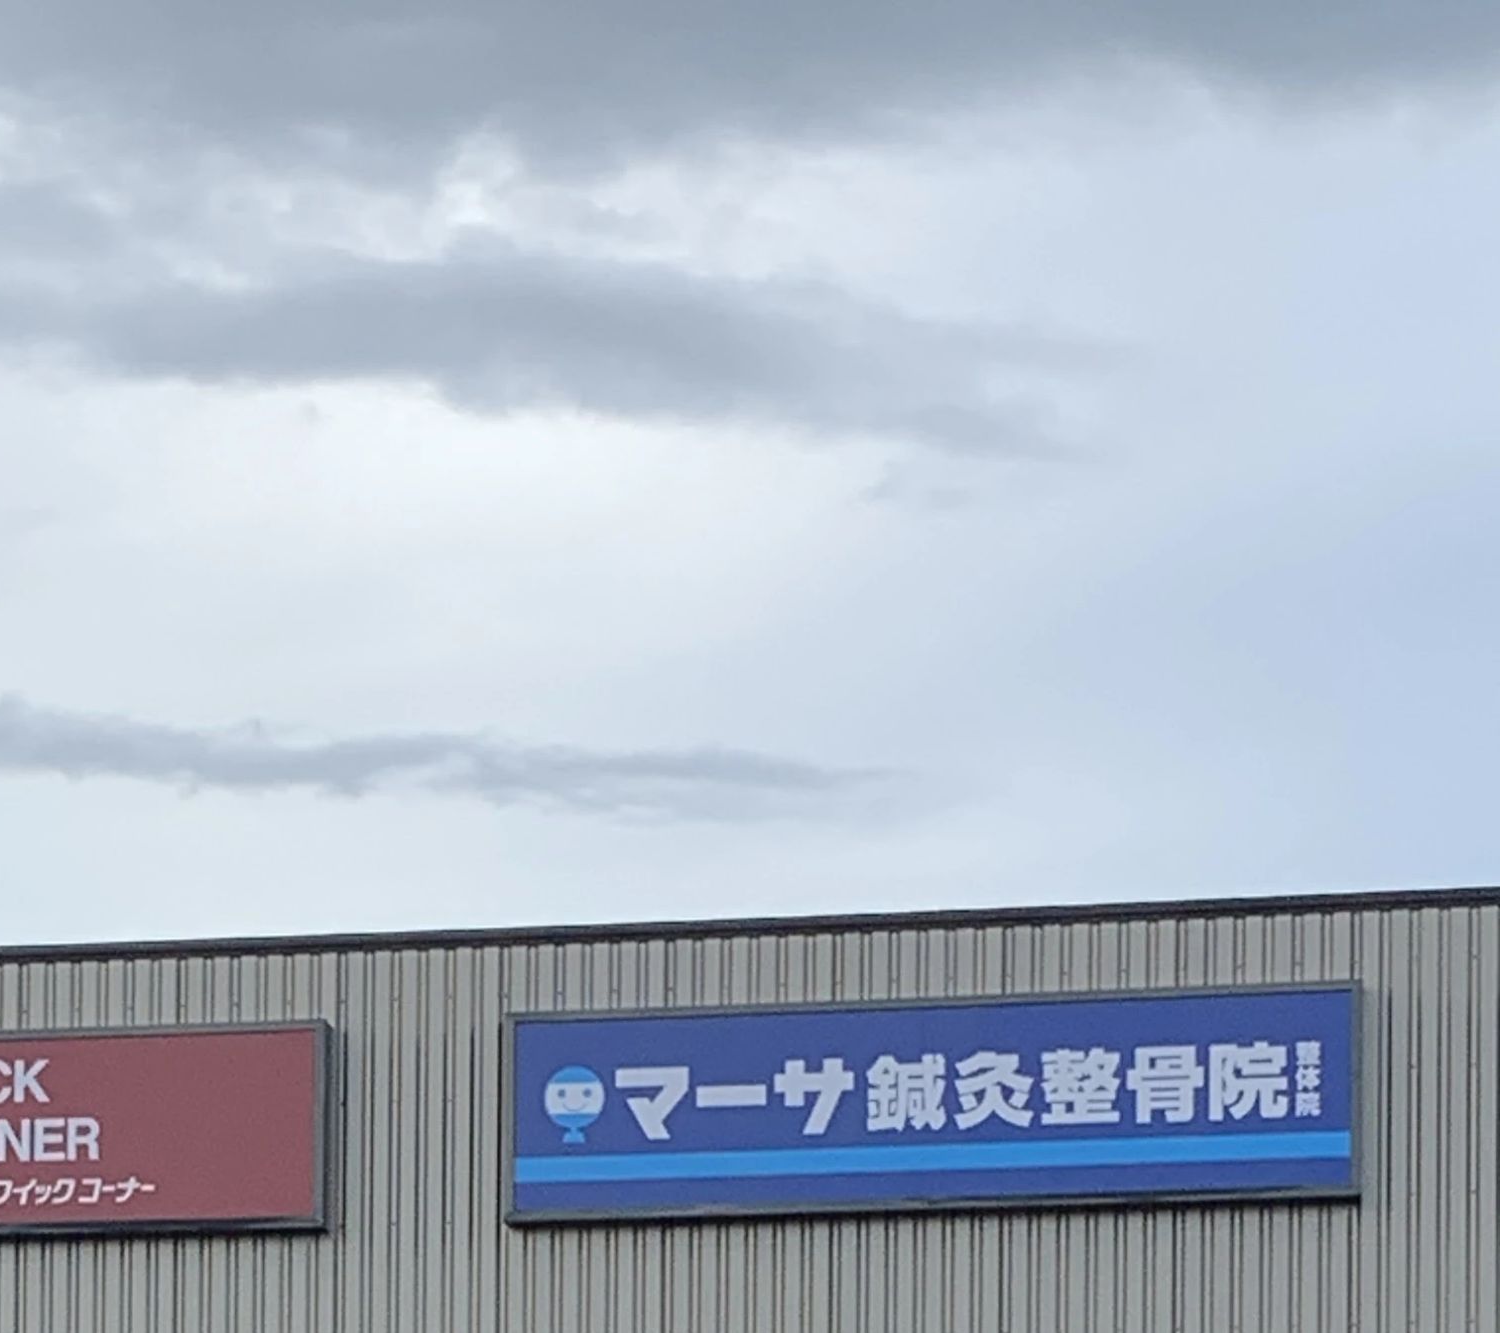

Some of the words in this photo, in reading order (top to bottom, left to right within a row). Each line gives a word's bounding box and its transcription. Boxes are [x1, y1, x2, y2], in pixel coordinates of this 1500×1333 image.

[614, 1041, 1288, 1140] マーサ鍼灸整骨院
